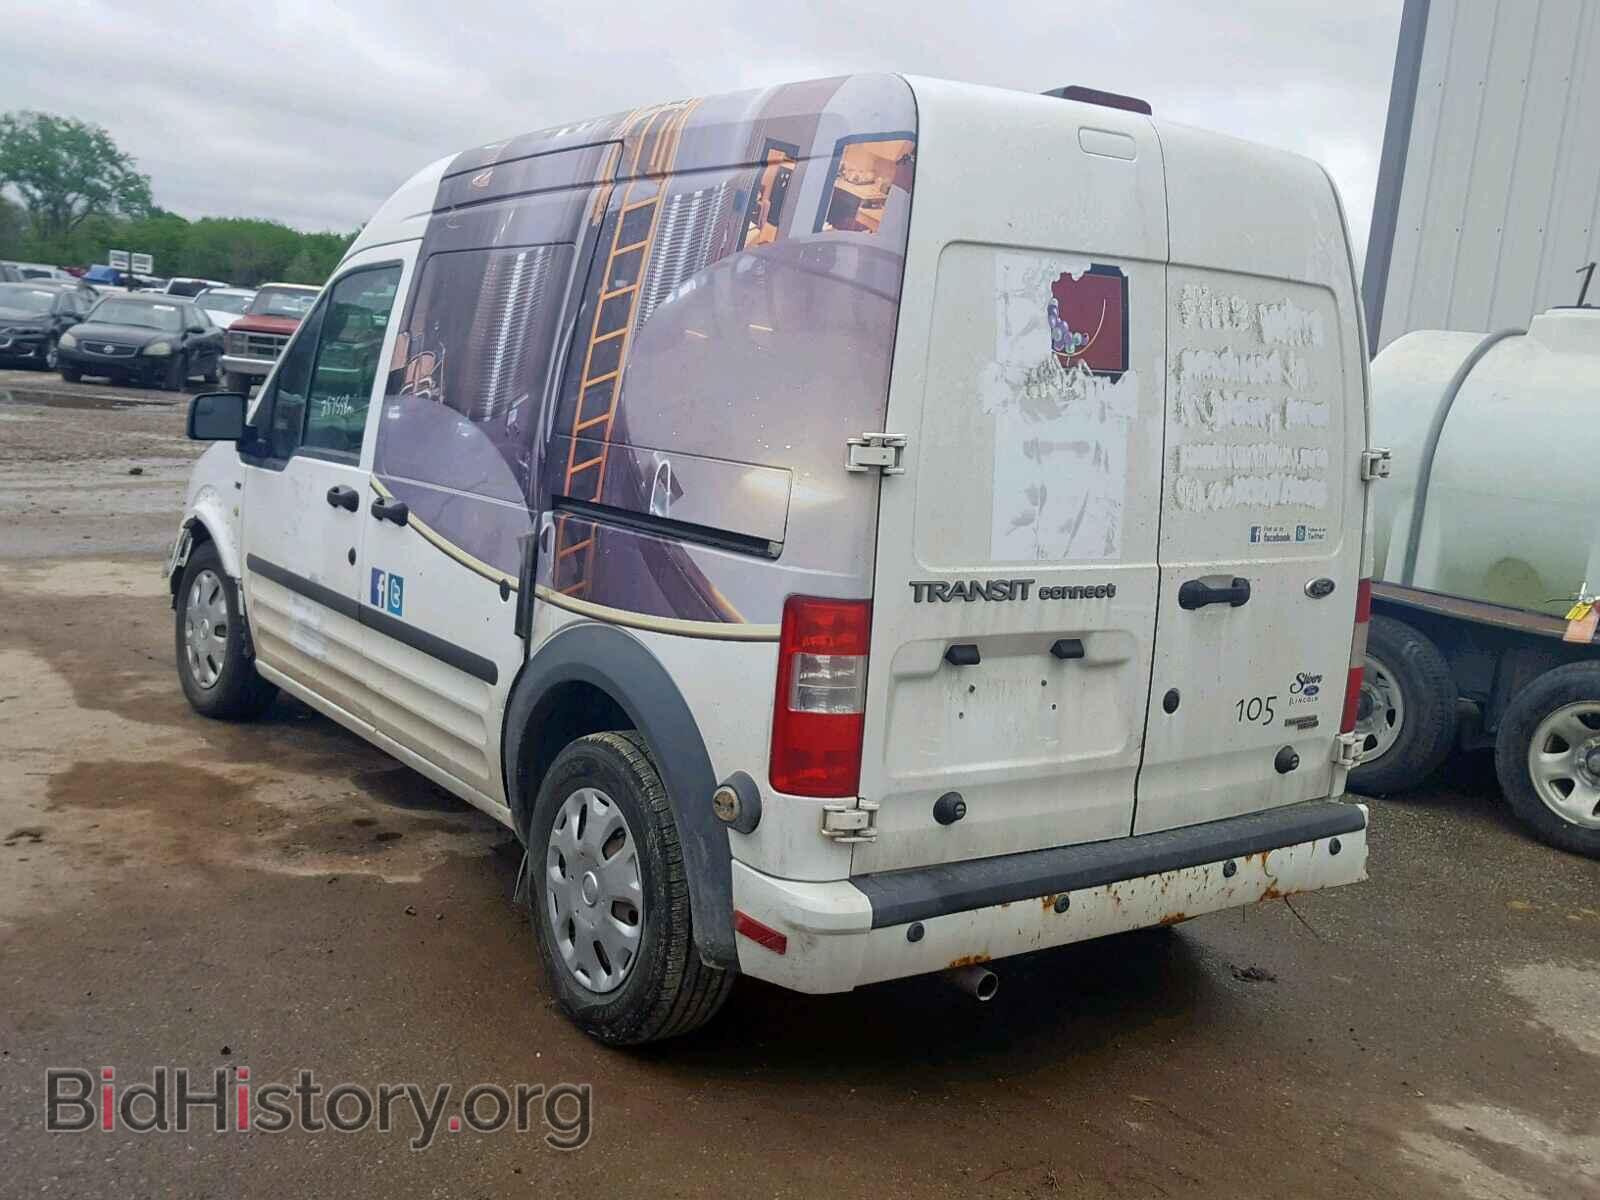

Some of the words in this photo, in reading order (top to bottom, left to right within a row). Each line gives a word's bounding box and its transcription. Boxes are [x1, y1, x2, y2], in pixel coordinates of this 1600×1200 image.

[909, 579, 1035, 603] TRANSIT
[1038, 582, 1117, 600] connect
[1235, 696, 1277, 726] 105
